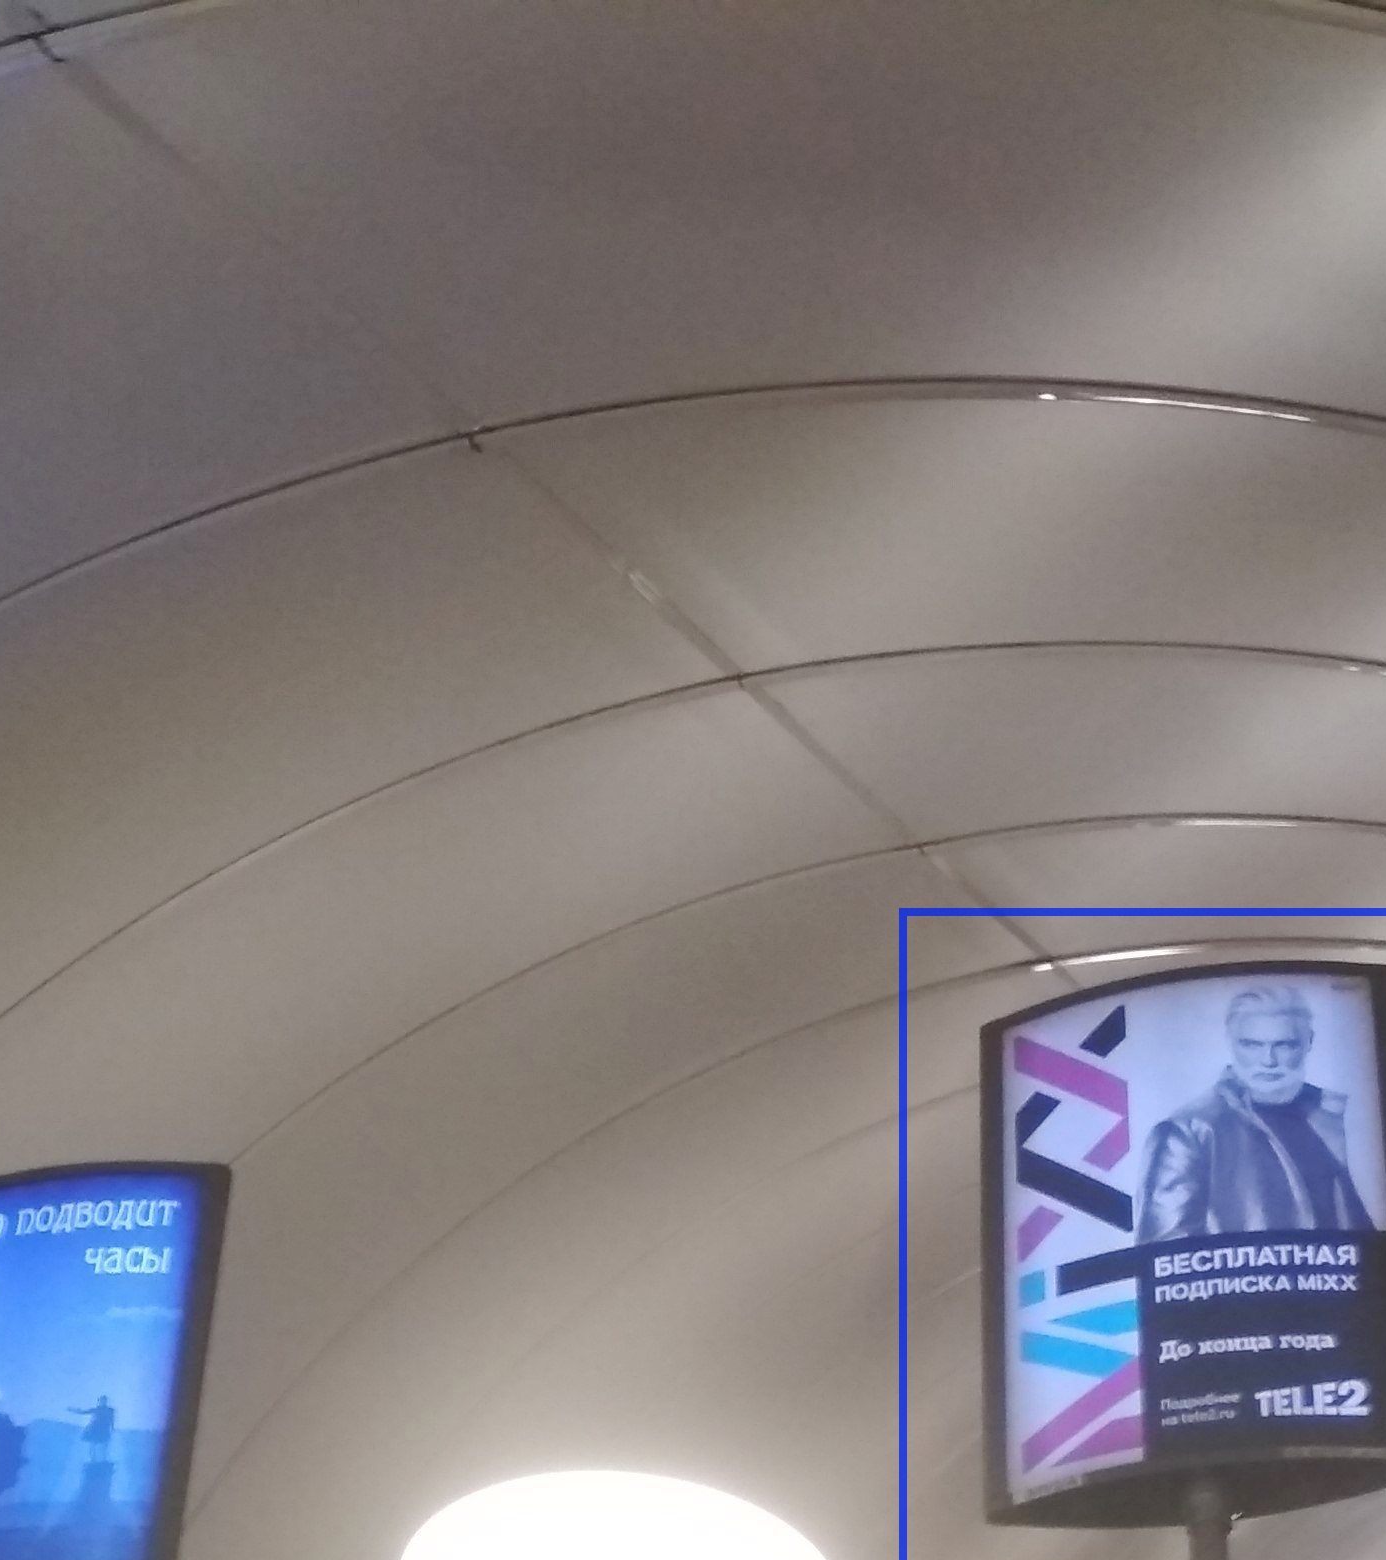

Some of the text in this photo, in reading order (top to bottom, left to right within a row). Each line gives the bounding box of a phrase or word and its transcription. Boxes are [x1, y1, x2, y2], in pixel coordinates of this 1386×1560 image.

[84, 1245, 172, 1275] часы
[1154, 1244, 1358, 1278] БЕСПЛАТНАЯ
[1154, 1274, 1291, 1303] ПОДПИСКА
[1159, 1333, 1336, 1364] До конца года
[1254, 1378, 1371, 1418] TELE2
